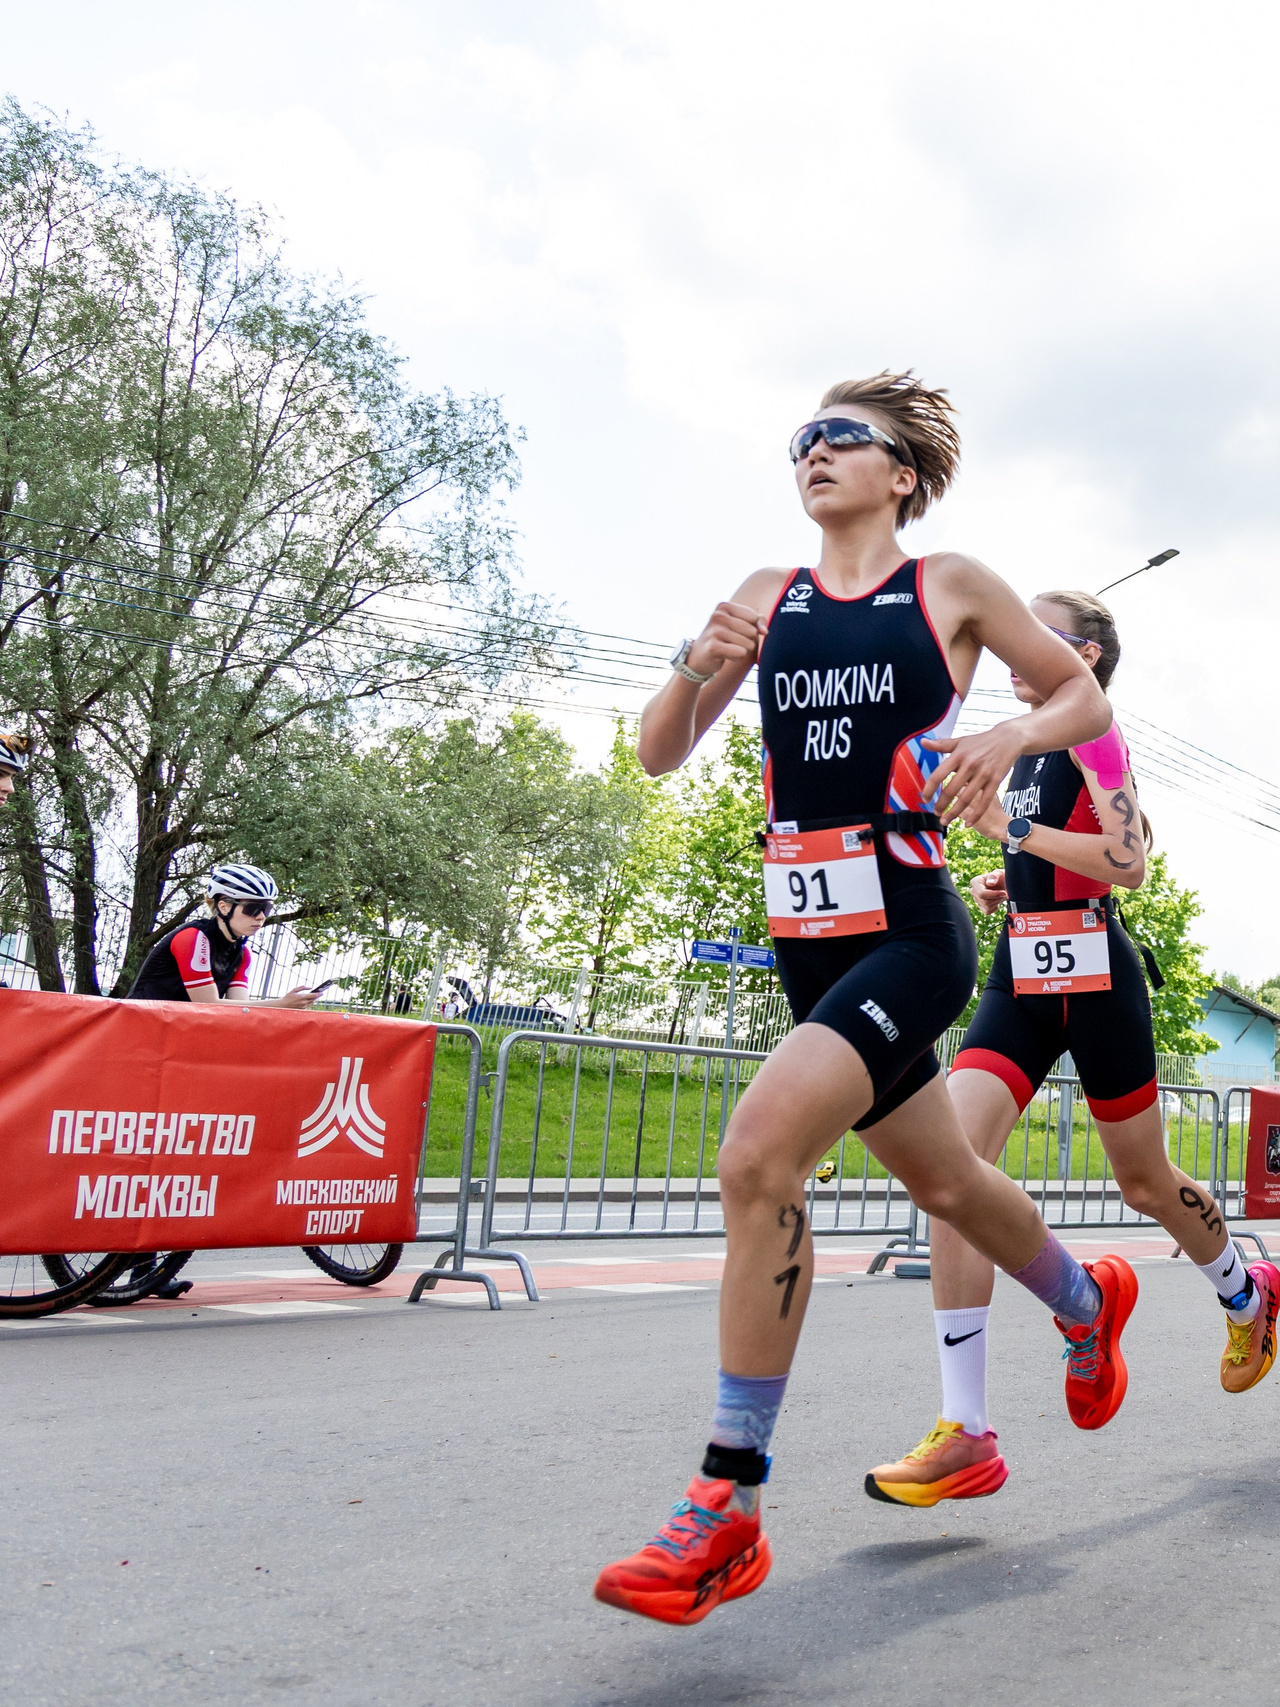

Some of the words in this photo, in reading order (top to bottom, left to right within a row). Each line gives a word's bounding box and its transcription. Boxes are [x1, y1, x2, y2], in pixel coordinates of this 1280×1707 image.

[774, 663, 895, 712] DOMKINA
[804, 716, 853, 762] RUS
[789, 869, 838, 912] 91
[1034, 940, 1076, 974] 95
[49, 1110, 256, 1156] ПЕРВЕНСТВО
[74, 1174, 218, 1219] МОСКВЫ
[276, 1173, 398, 1205] МОСКОВСКИЙ
[1179, 1186, 1222, 1236] 95
[305, 1209, 364, 1235] СПОРТ
[774, 1204, 805, 1320] 91
